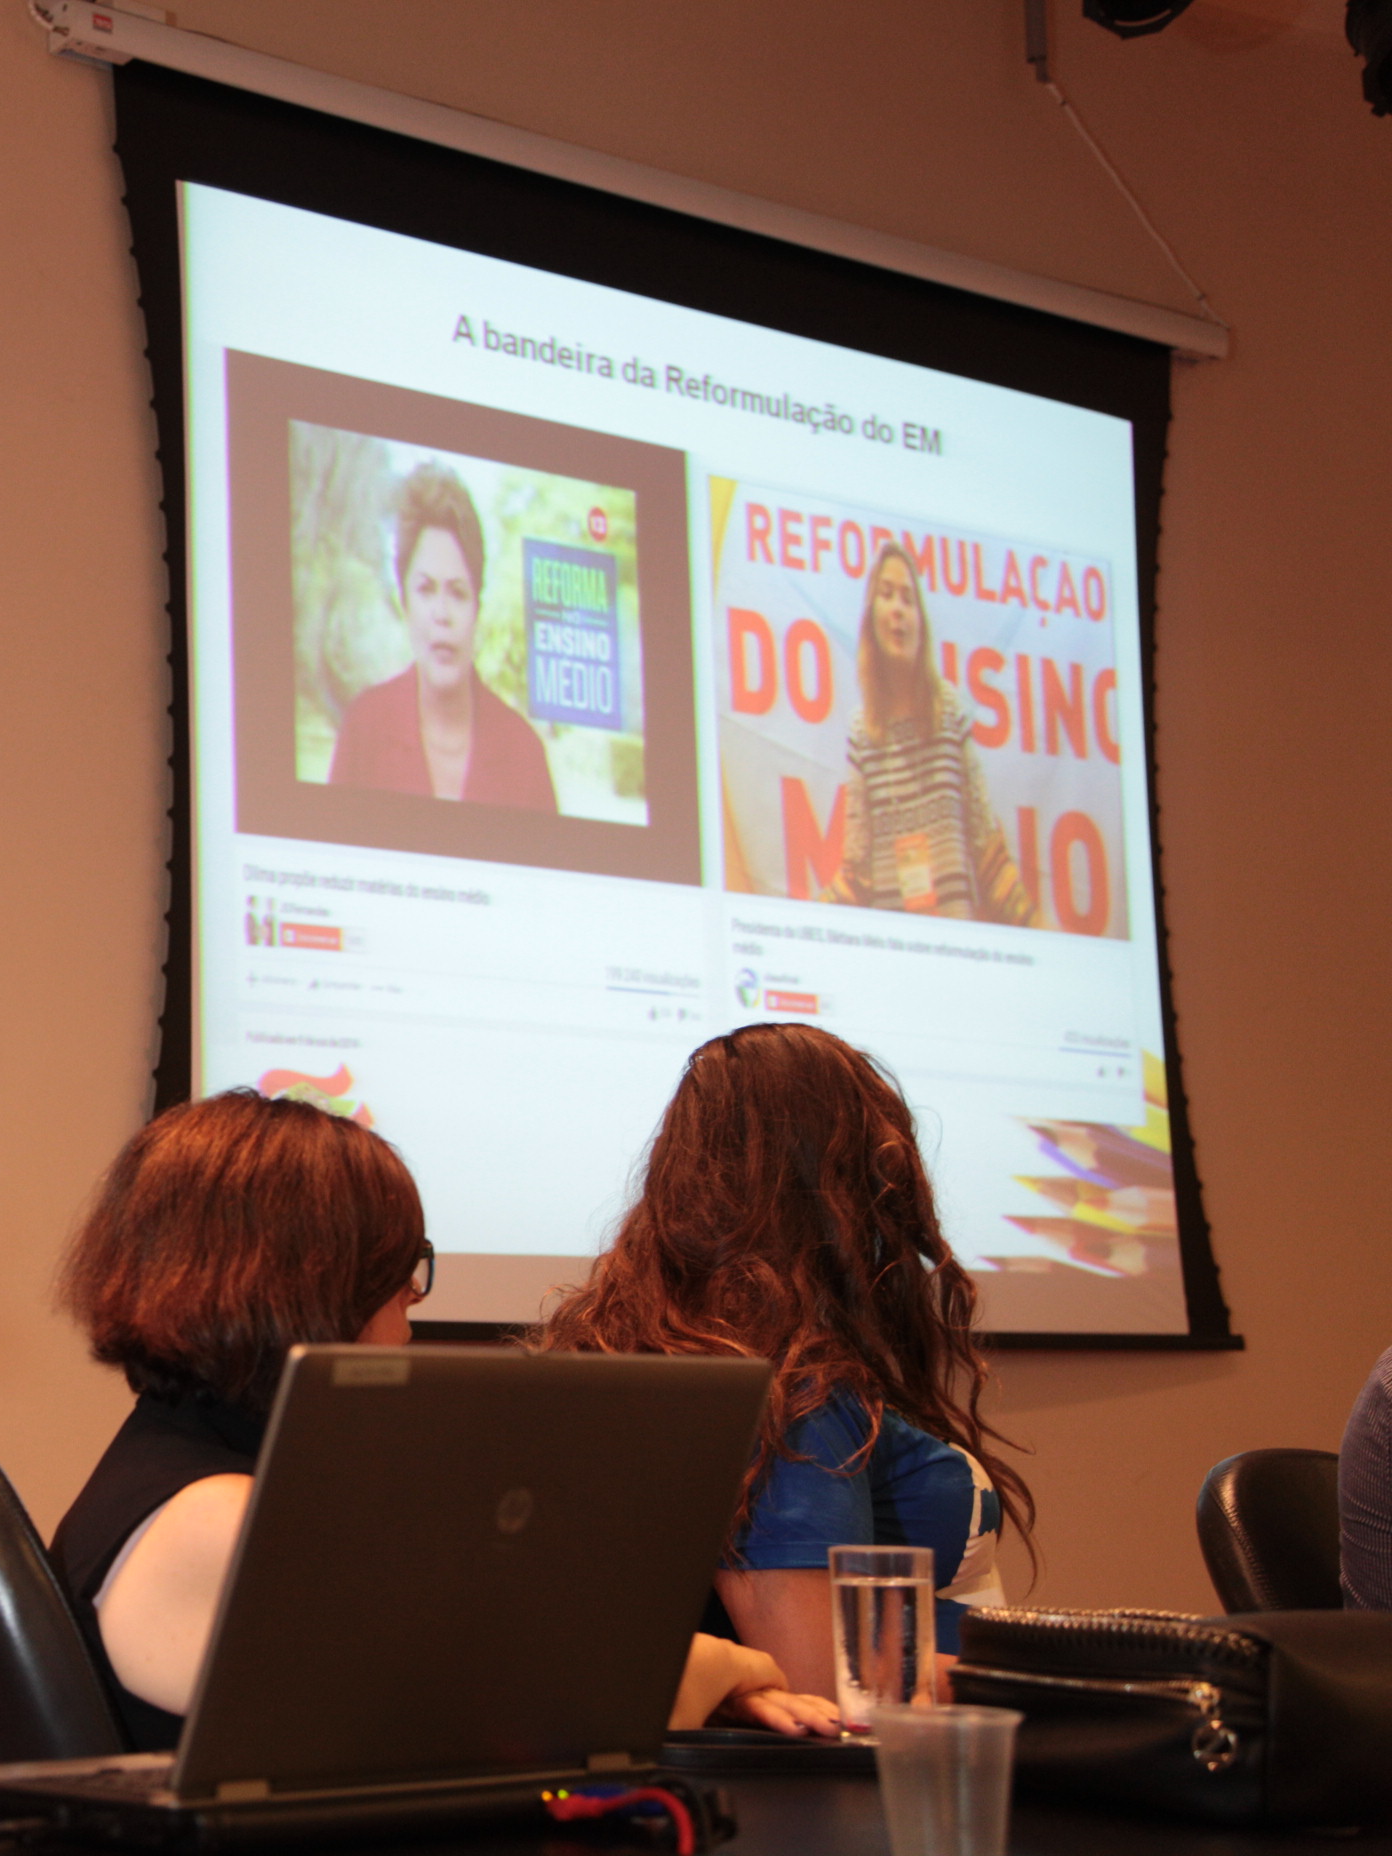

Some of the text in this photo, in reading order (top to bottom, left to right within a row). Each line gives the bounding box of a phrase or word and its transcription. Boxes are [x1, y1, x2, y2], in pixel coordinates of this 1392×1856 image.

[452, 314, 942, 455] A bandeira da Reformulação do EM
[531, 556, 609, 615] REFORMA
[533, 620, 611, 663] ENSINO
[727, 606, 834, 725] DO
